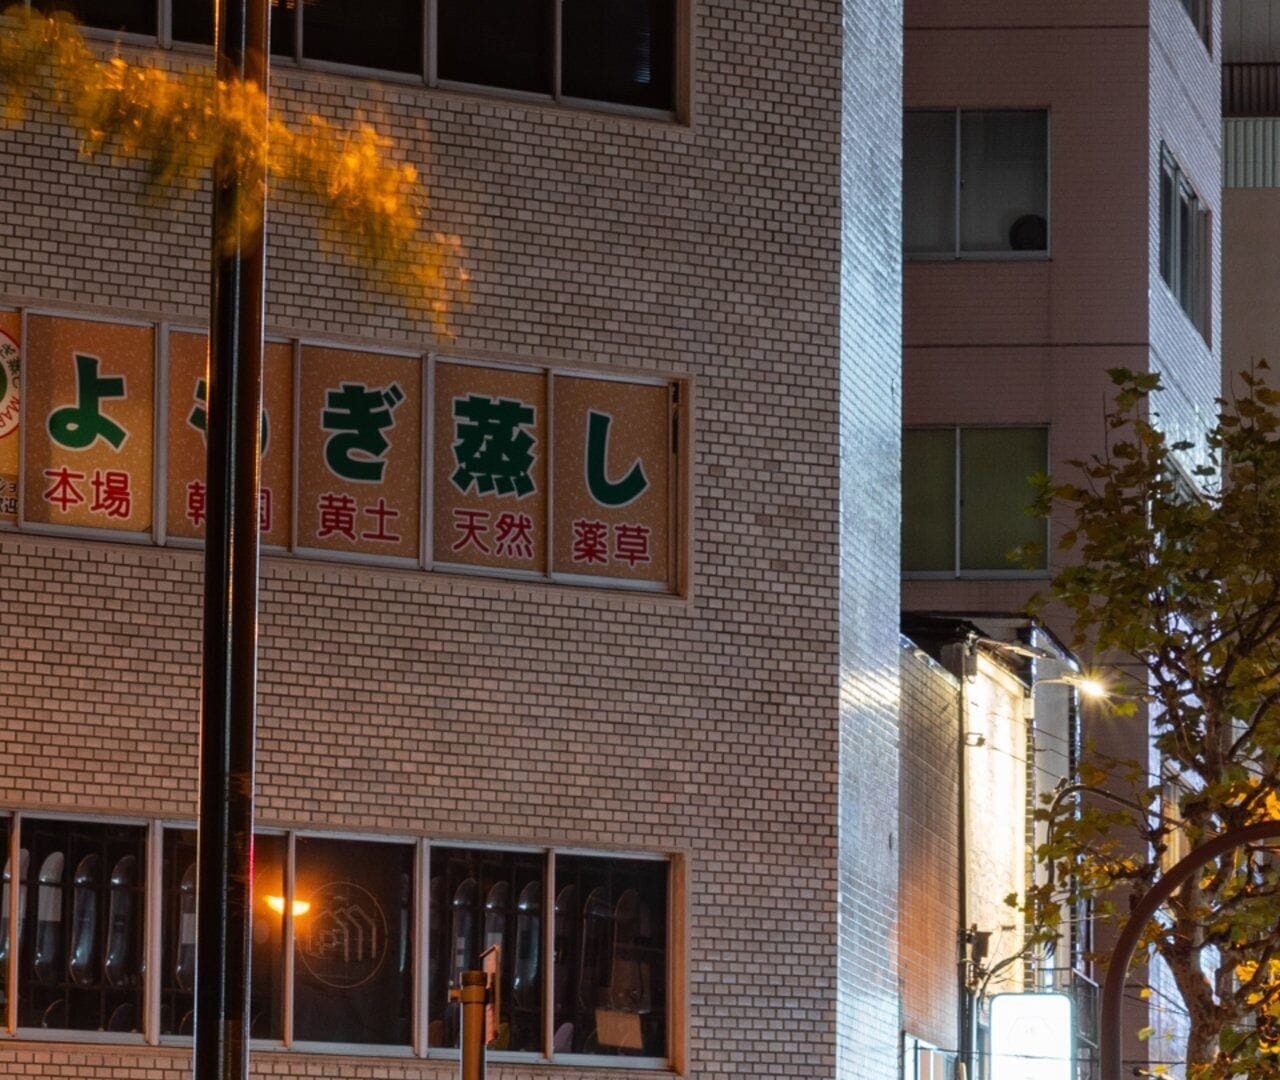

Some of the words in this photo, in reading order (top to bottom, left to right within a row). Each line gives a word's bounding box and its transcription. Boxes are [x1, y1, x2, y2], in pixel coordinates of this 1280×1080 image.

[44, 468, 131, 518] 本場
[318, 495, 401, 542] 黄土
[452, 507, 534, 560] 天然
[572, 519, 652, 566] 薬草
